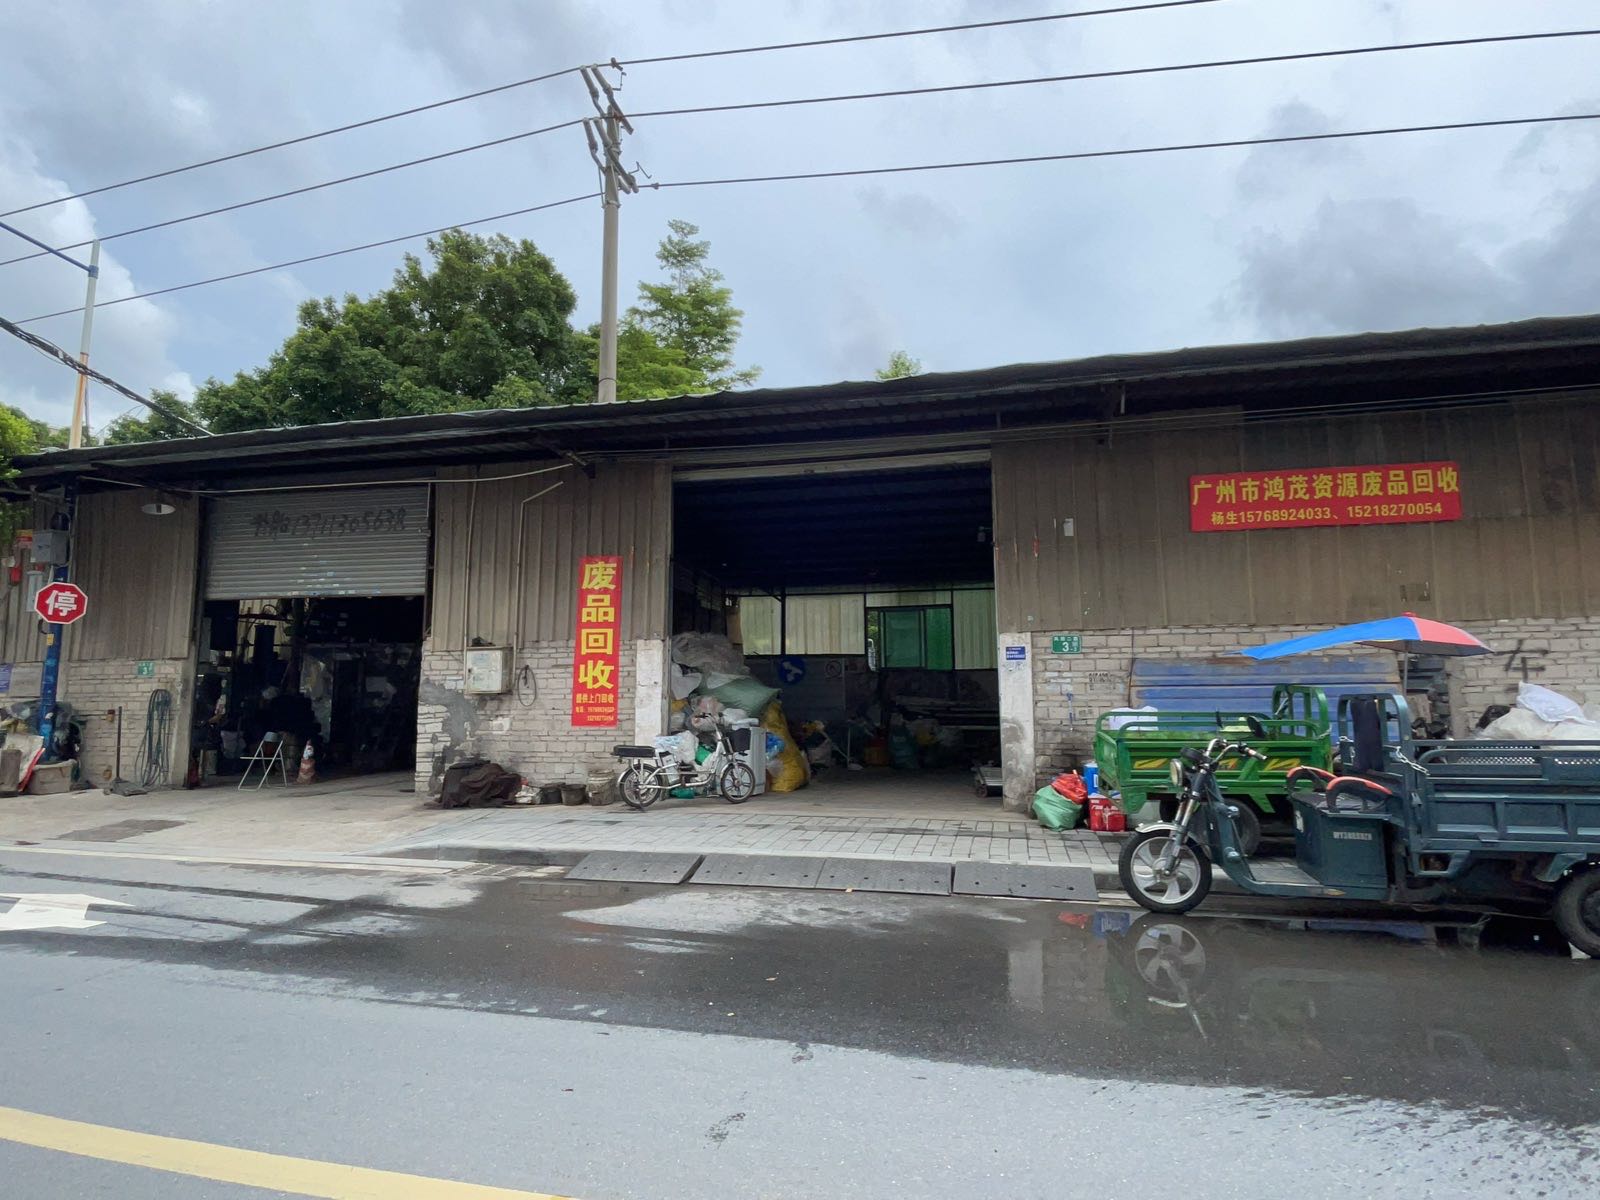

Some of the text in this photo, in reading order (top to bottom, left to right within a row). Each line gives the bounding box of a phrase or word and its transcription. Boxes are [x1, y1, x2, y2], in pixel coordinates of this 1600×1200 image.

[1193, 468, 1459, 505] 广州市鸿茂资源废品回收
[45, 589, 78, 617] 停
[579, 561, 617, 689] 废品回收
